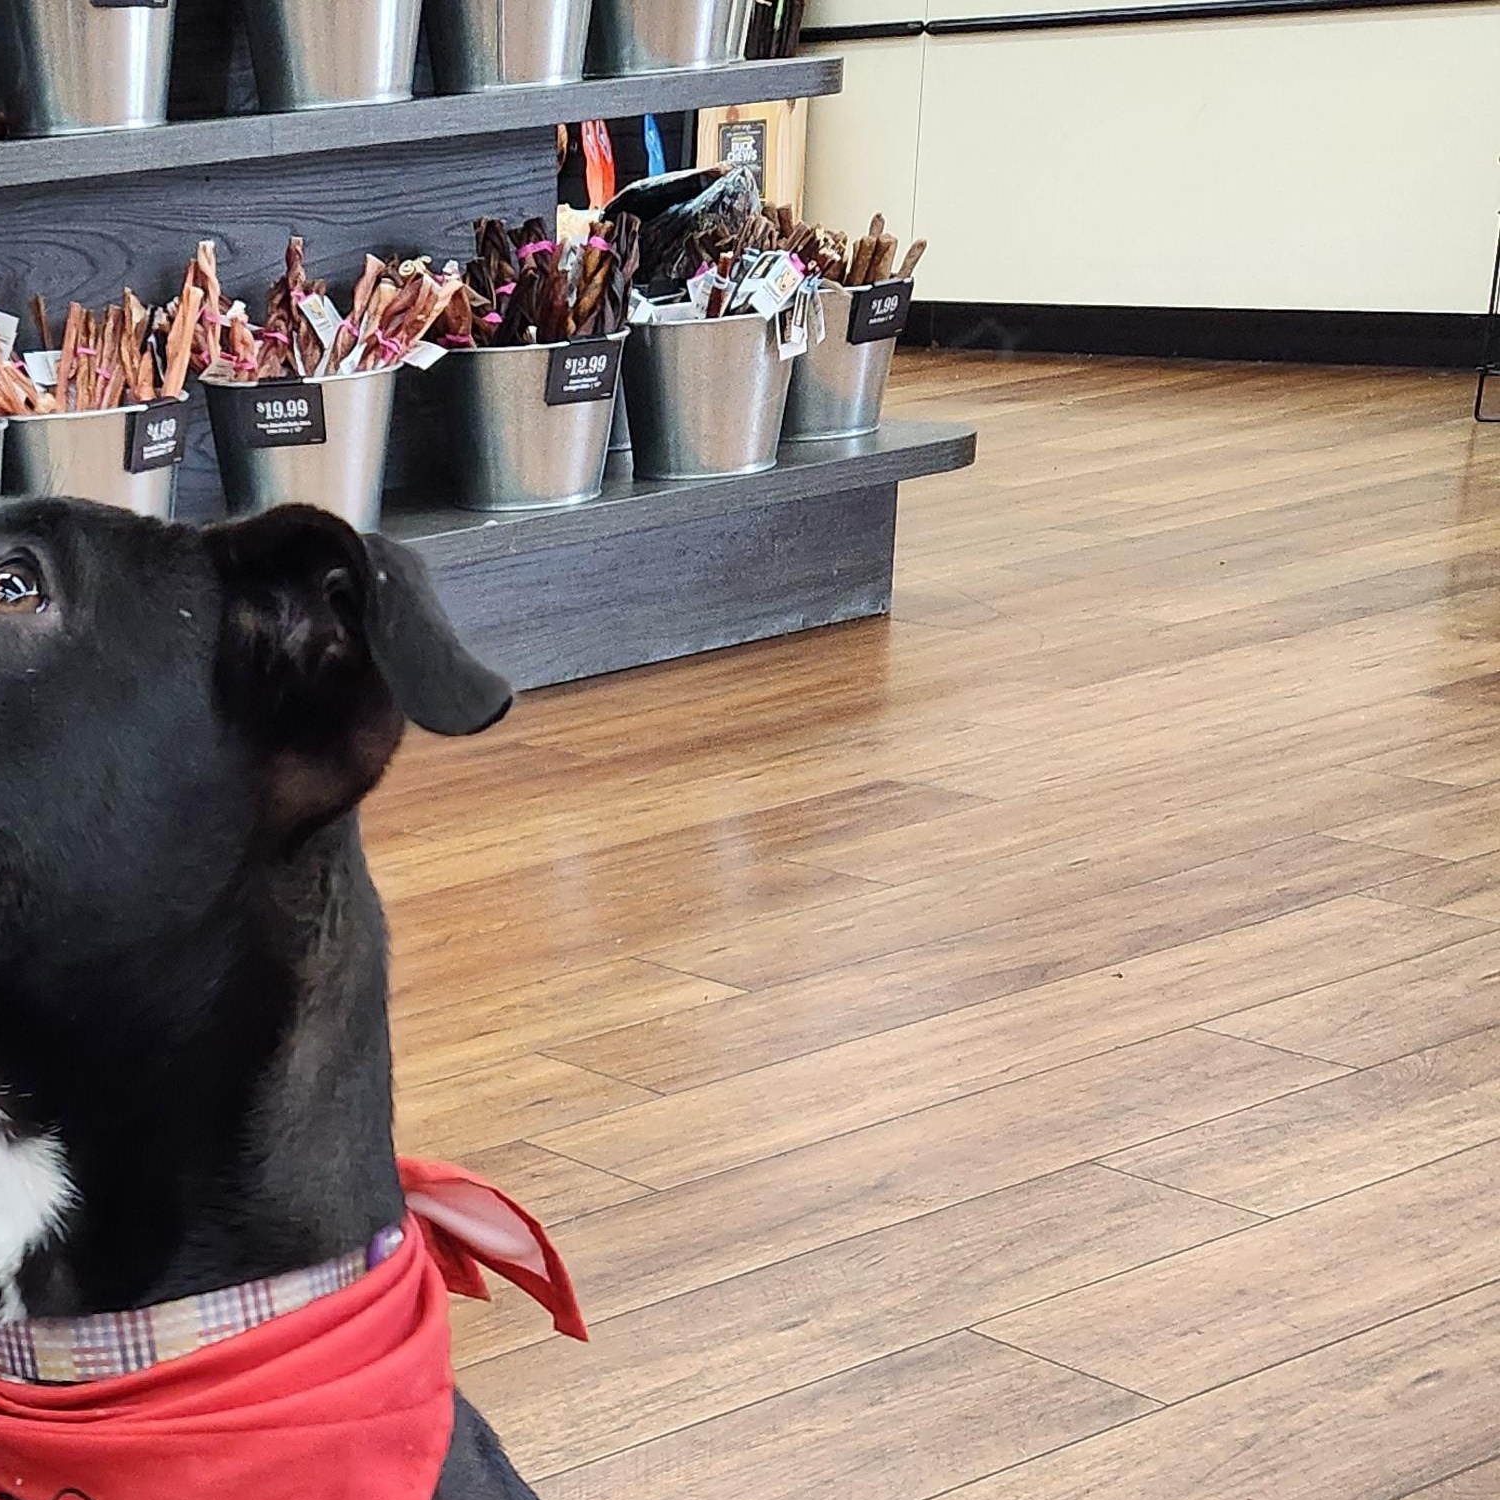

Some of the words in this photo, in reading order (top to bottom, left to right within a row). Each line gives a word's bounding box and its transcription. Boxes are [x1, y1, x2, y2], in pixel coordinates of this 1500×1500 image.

[871, 294, 899, 316] $1.99
[564, 354, 607, 376] $12.99
[256, 398, 308, 420] $19.99
